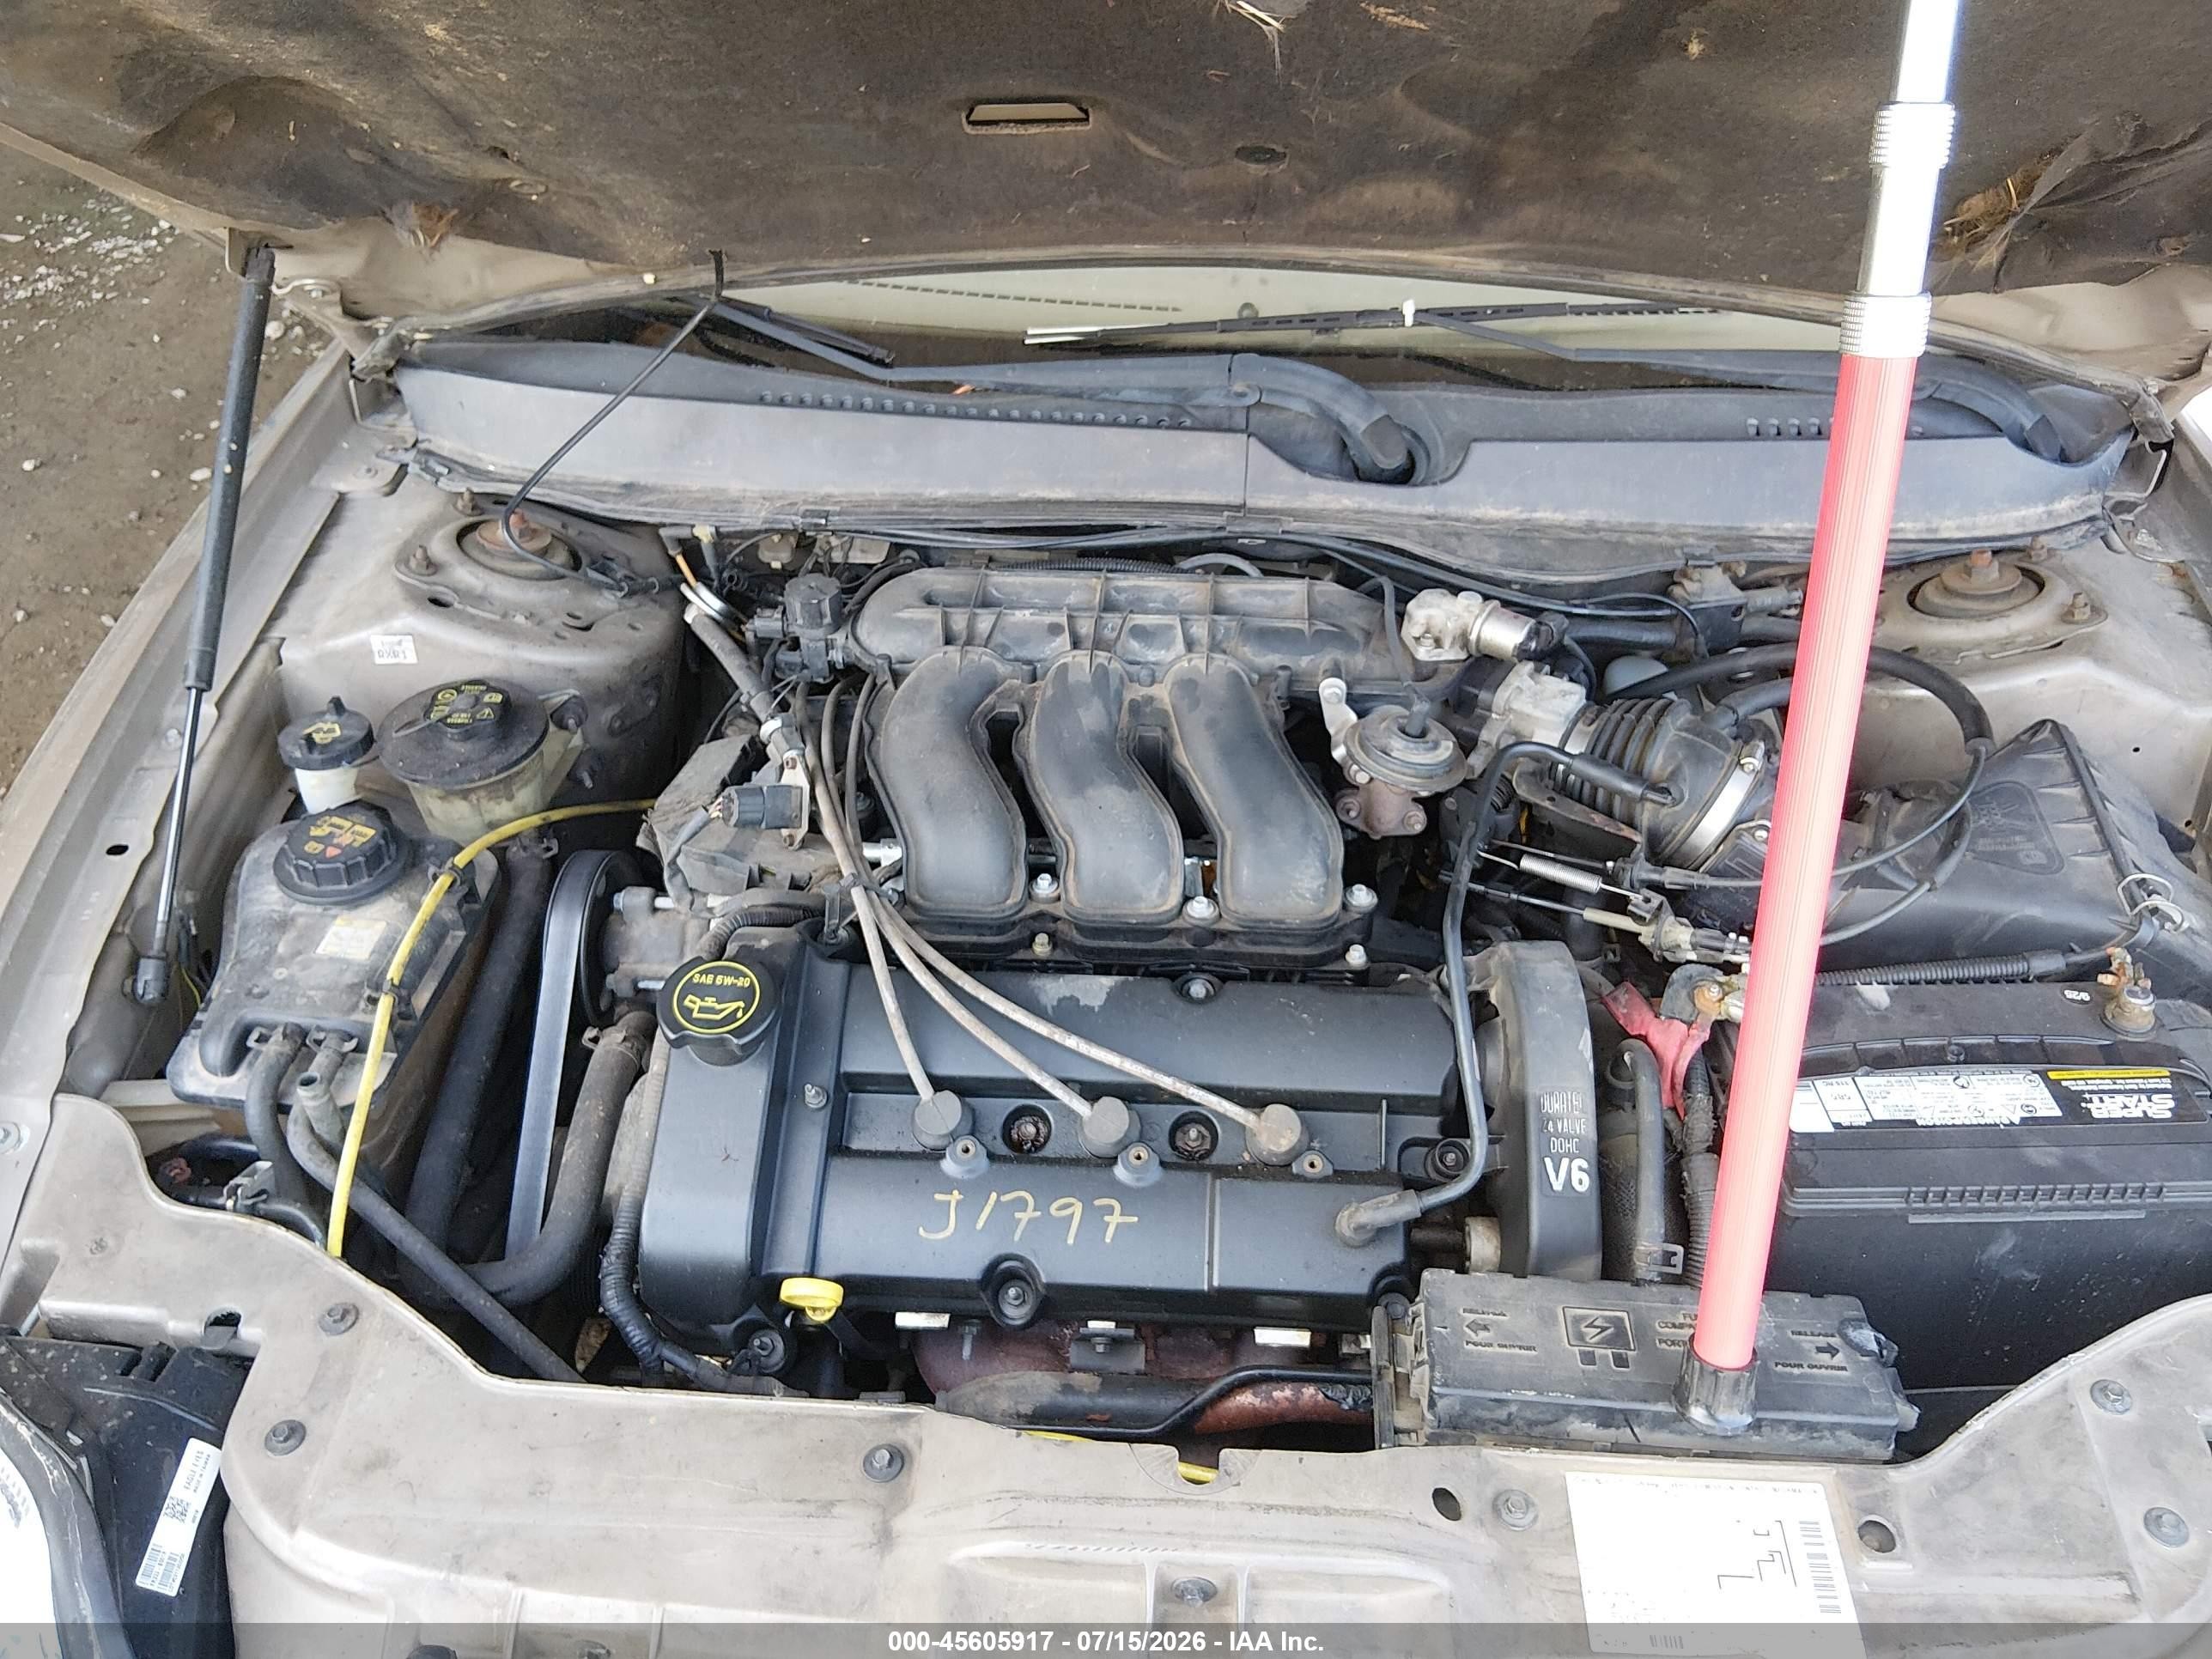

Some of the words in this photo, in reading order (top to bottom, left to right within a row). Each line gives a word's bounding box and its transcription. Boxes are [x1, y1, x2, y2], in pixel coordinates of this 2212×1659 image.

[692, 973, 714, 985] SAE
[715, 975, 750, 988] 5W-20
[1556, 1118, 1587, 1134] VALVE
[1550, 1138, 1580, 1154] DOHC
[1544, 1157, 1589, 1193] V6
[919, 1189, 1139, 1244] J1797
[1773, 1360, 1805, 1370] POUR
[1807, 1363, 1849, 1372] OUVRIR
